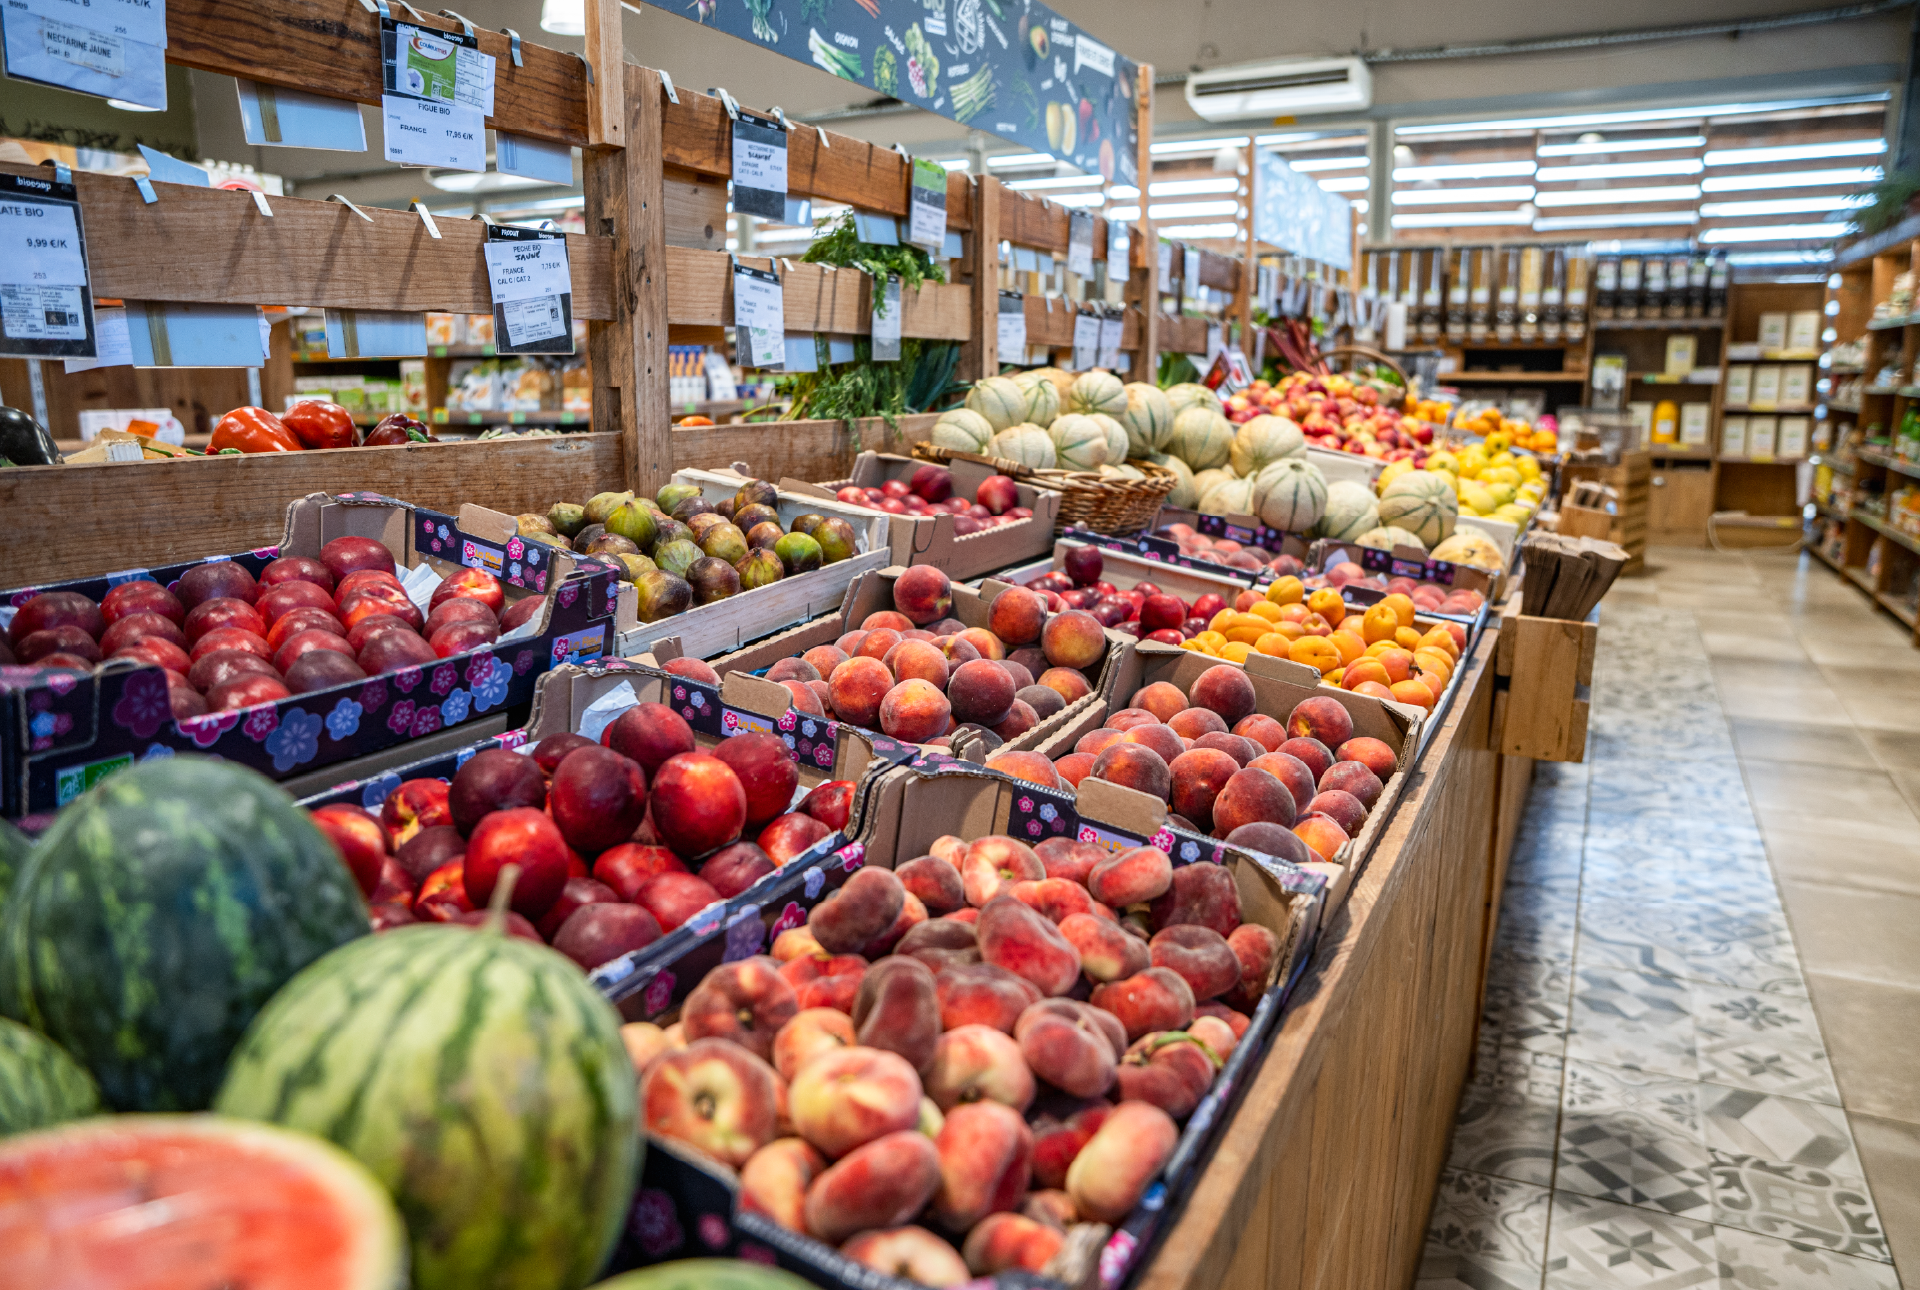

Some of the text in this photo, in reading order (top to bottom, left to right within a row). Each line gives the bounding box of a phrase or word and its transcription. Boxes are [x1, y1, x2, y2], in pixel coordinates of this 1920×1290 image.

[47, 31, 87, 51] NECTARINE
[89, 44, 111, 58] JAUNE
[418, 103, 451, 115] FIGUE BIO
[400, 124, 427, 134] FRANCE
[0, 206, 44, 217] ATE BIO
[501, 229, 519, 237] PRODUIT
[27, 238, 68, 249] 9,99 €/K
[513, 244, 542, 253] PECHE BIO
[502, 267, 525, 275] FRANCE
[475, 549, 484, 559] La
[569, 634, 603, 652] La Fleur
